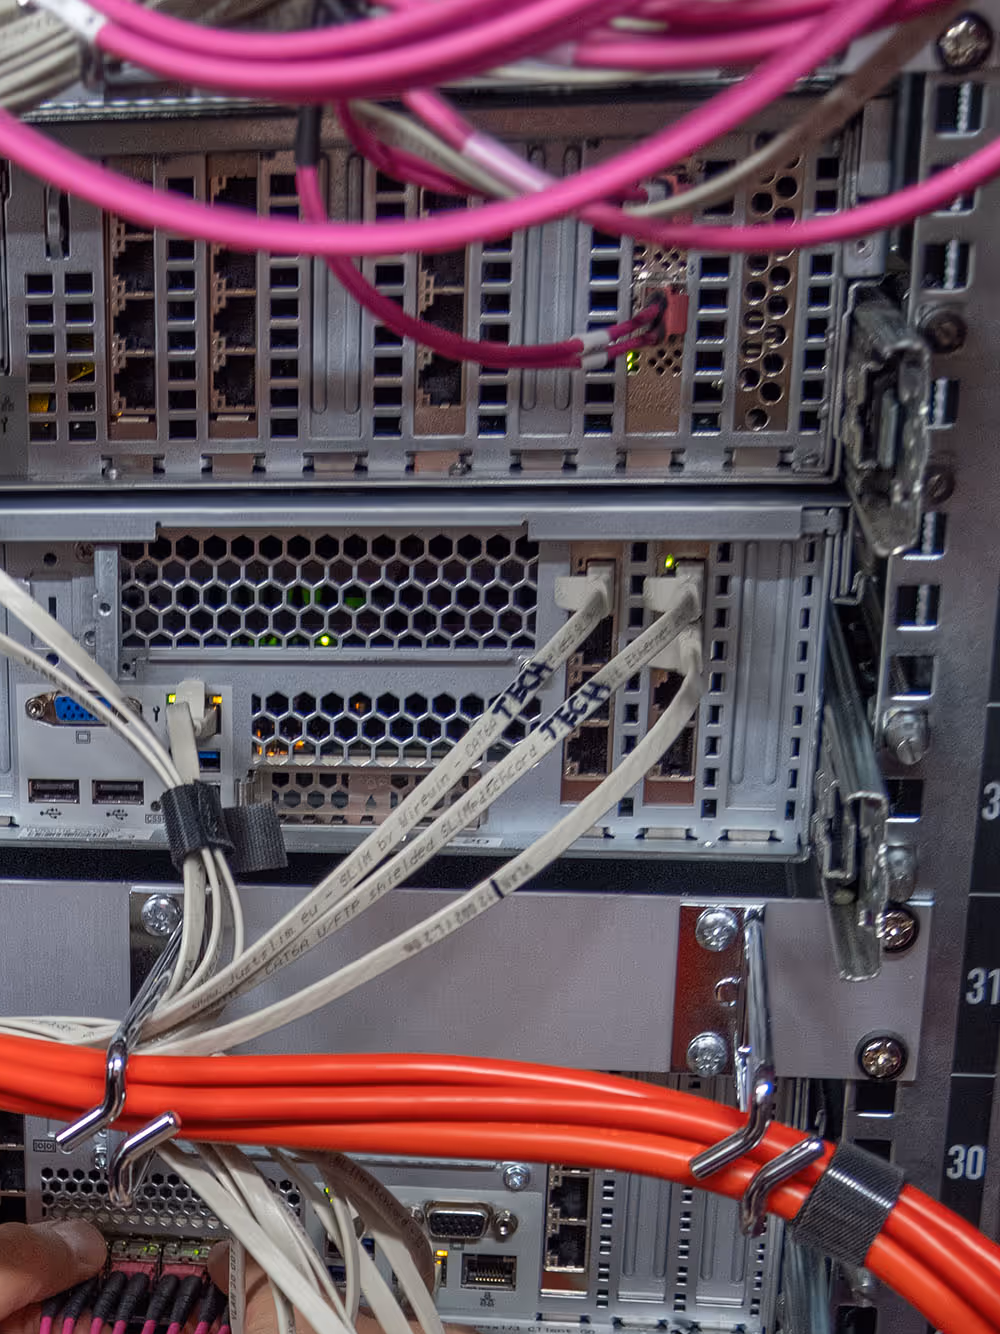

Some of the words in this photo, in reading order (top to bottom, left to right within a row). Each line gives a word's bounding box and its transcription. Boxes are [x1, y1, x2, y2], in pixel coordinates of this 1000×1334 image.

[492, 661, 554, 720] TECH
[539, 680, 612, 741] TECH
[966, 967, 1000, 1005] 31
[946, 1144, 986, 1181] 30
